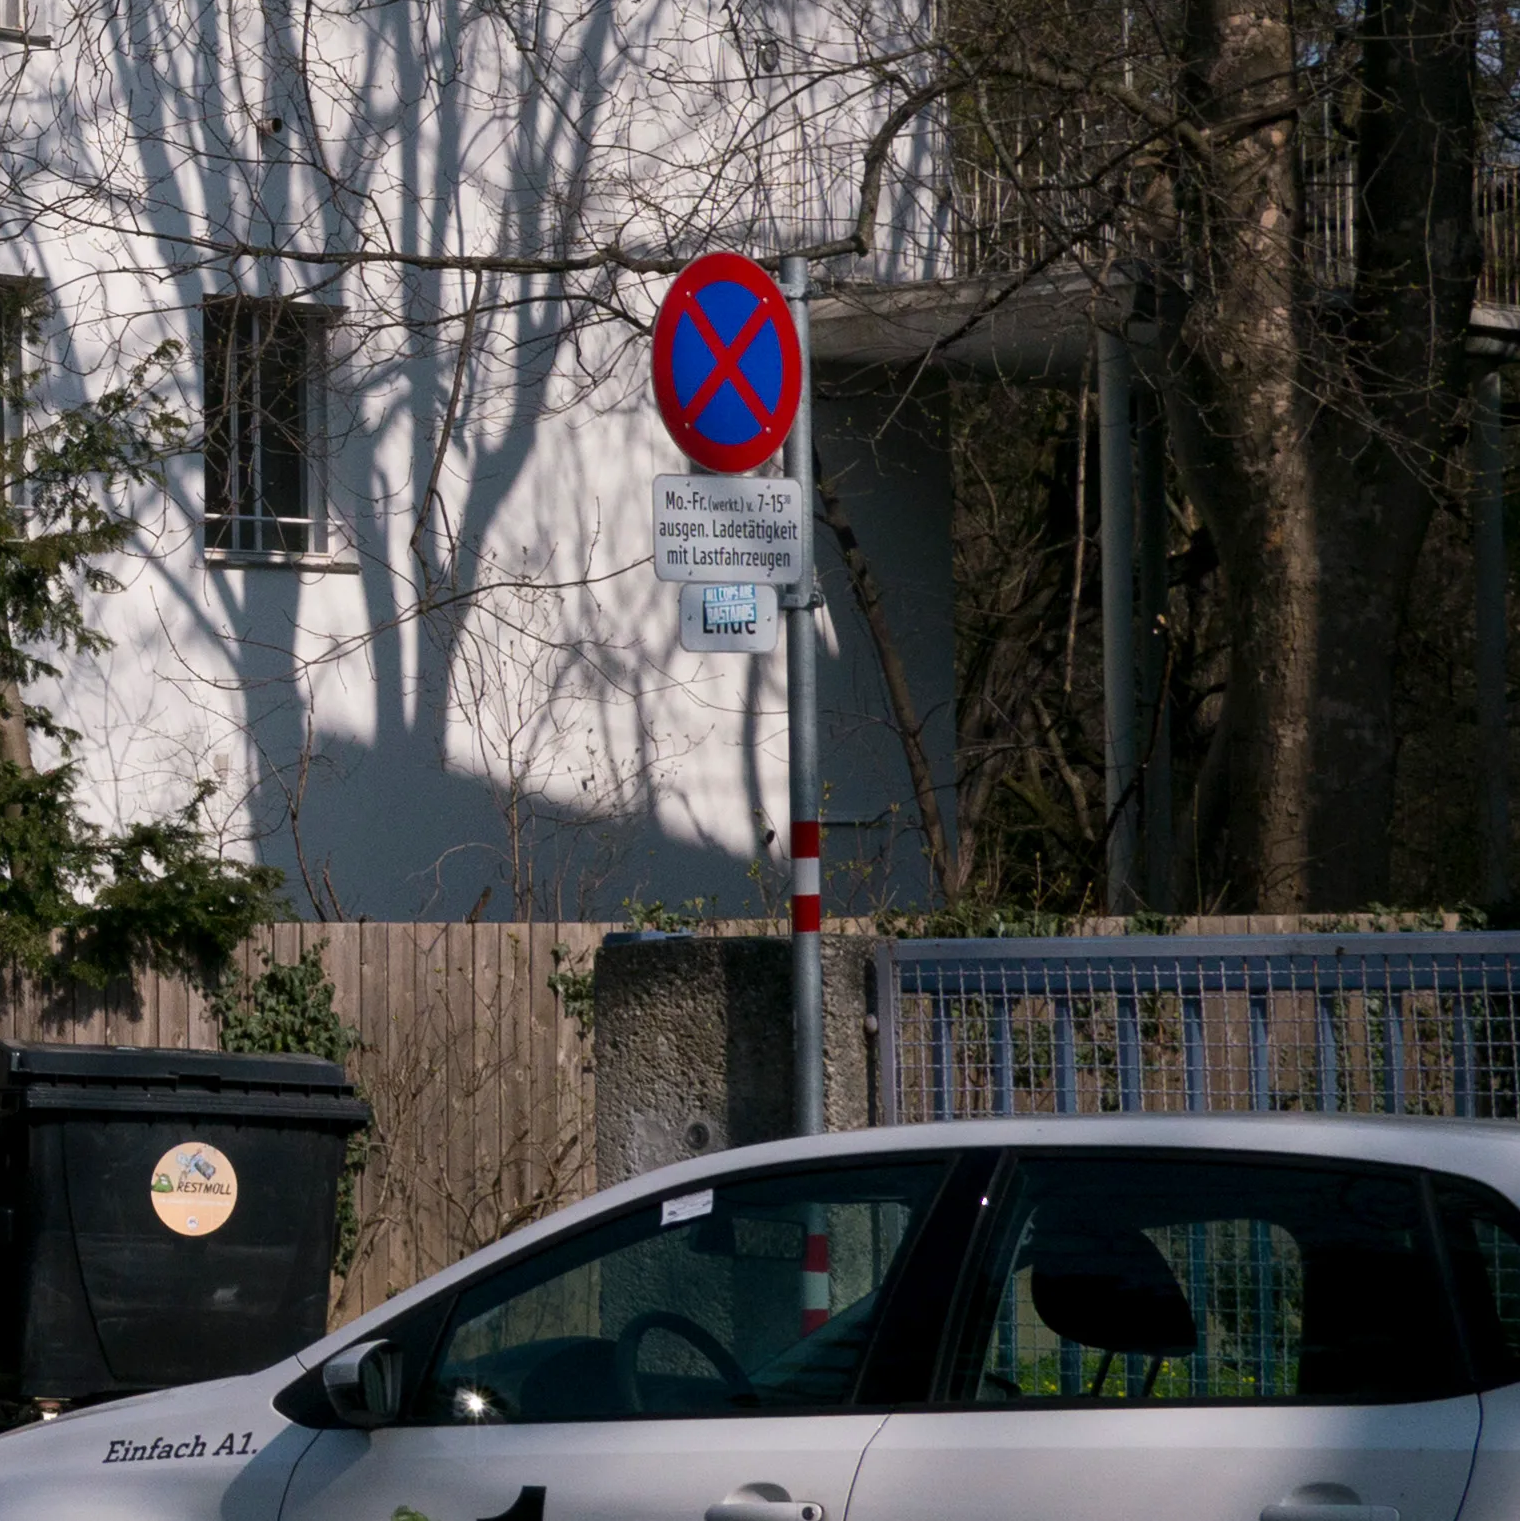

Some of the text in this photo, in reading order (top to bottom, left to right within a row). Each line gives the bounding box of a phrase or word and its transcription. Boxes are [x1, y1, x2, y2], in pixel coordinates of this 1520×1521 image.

[659, 520, 798, 543] ausgen. Ladetätigkeit
[667, 545, 791, 571] mit Lastfahrzeugen
[102, 1432, 259, 1463] Einfach A1.
